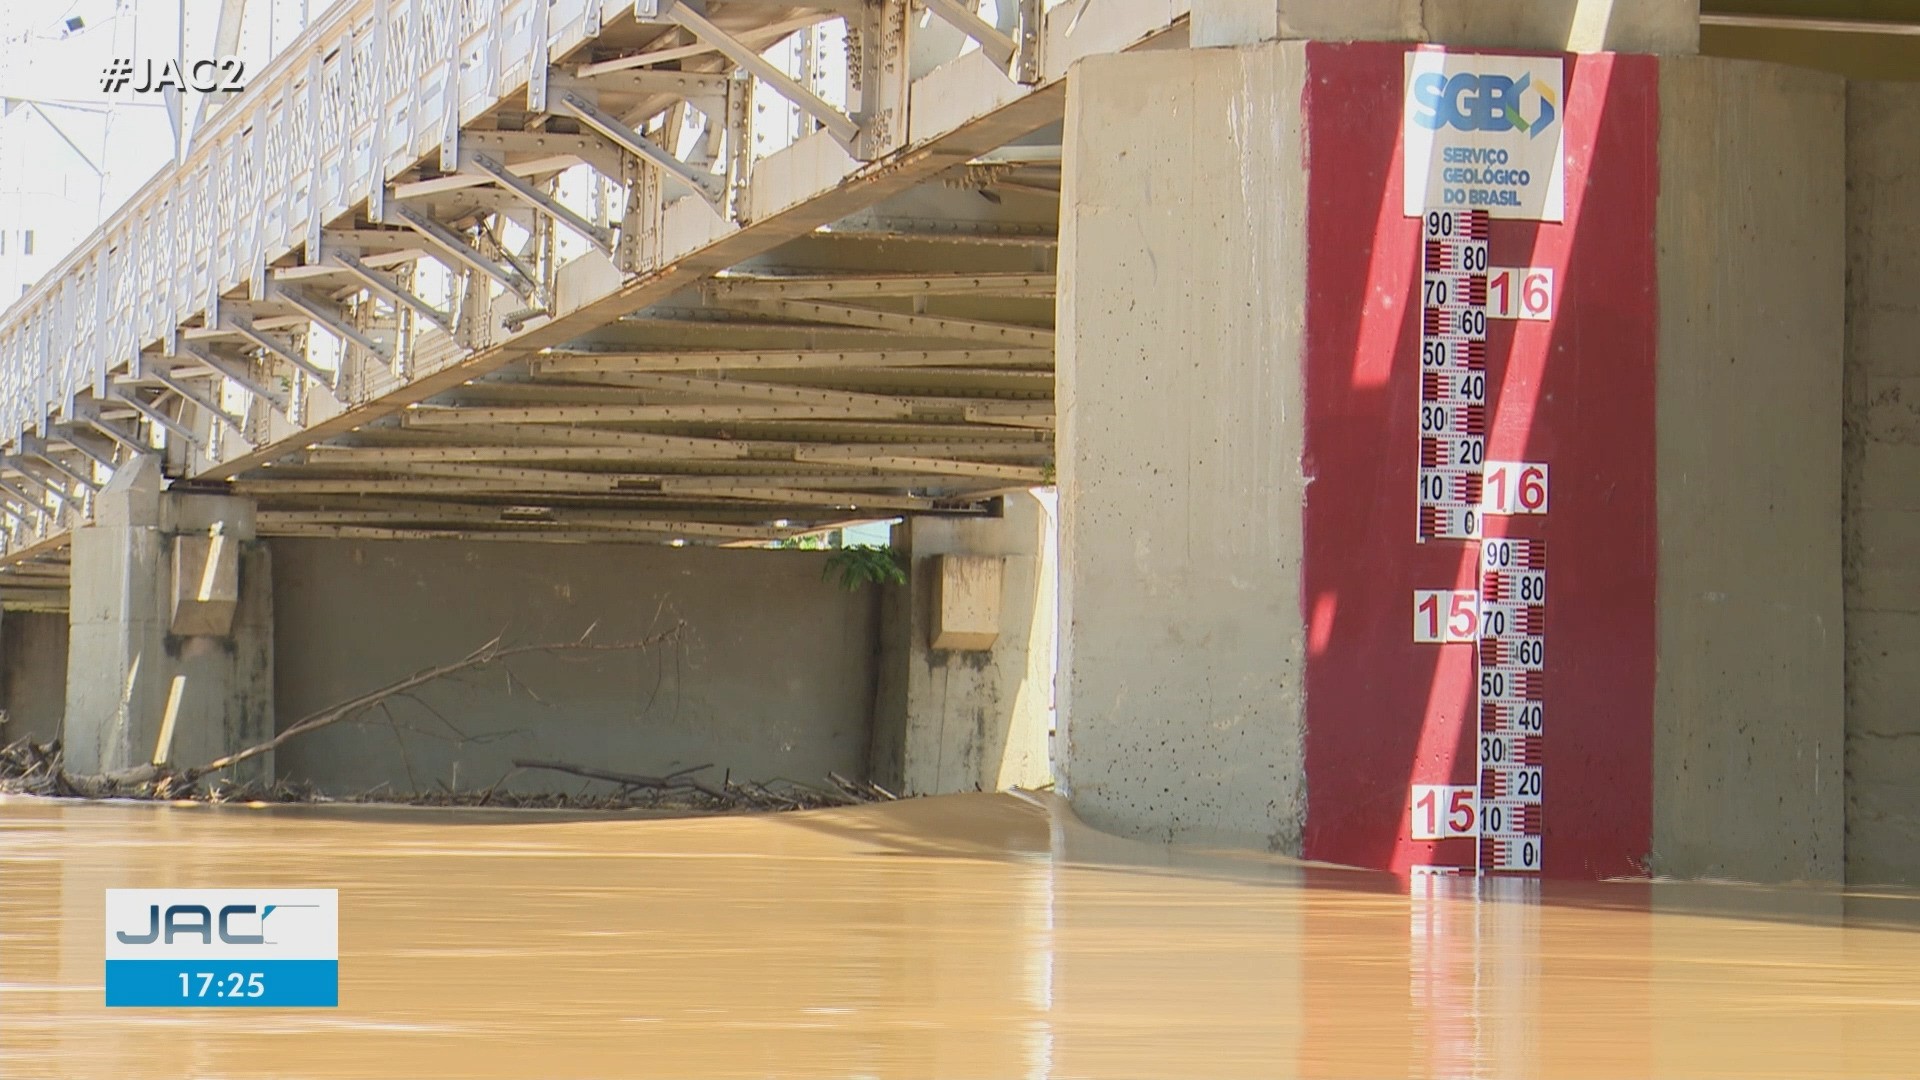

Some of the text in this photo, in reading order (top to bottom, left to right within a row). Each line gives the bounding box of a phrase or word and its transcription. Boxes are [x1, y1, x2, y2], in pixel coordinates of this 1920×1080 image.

[1413, 72, 1515, 131] SGB
[1443, 147, 1508, 166] SERVIÇO
[1443, 166, 1530, 186] GEOLÓGICO
[1443, 188, 1522, 206] DO BRASIL
[1429, 212, 1452, 236] 90
[1463, 246, 1486, 271] 80
[1425, 281, 1447, 305] 70
[1490, 271, 1549, 316] 16
[1462, 310, 1485, 335] 60
[1423, 342, 1446, 366] 50
[1461, 376, 1484, 400] 40
[1422, 406, 1444, 431] 30
[1459, 441, 1483, 465] 20
[1421, 475, 1443, 500] 10
[1487, 467, 1545, 510] 16
[1464, 511, 1475, 535] 0
[1487, 542, 1510, 566] 90
[1521, 576, 1543, 601] 80
[1419, 594, 1477, 638] 15
[1482, 611, 1504, 635] 70
[1520, 640, 1542, 665] 60
[1481, 673, 1503, 697] 50
[1518, 706, 1542, 730] 40
[1481, 738, 1502, 762] 30
[1518, 771, 1541, 796] 20
[1417, 789, 1475, 834] 15
[1480, 807, 1501, 832] 10
[1523, 842, 1534, 866] 0
